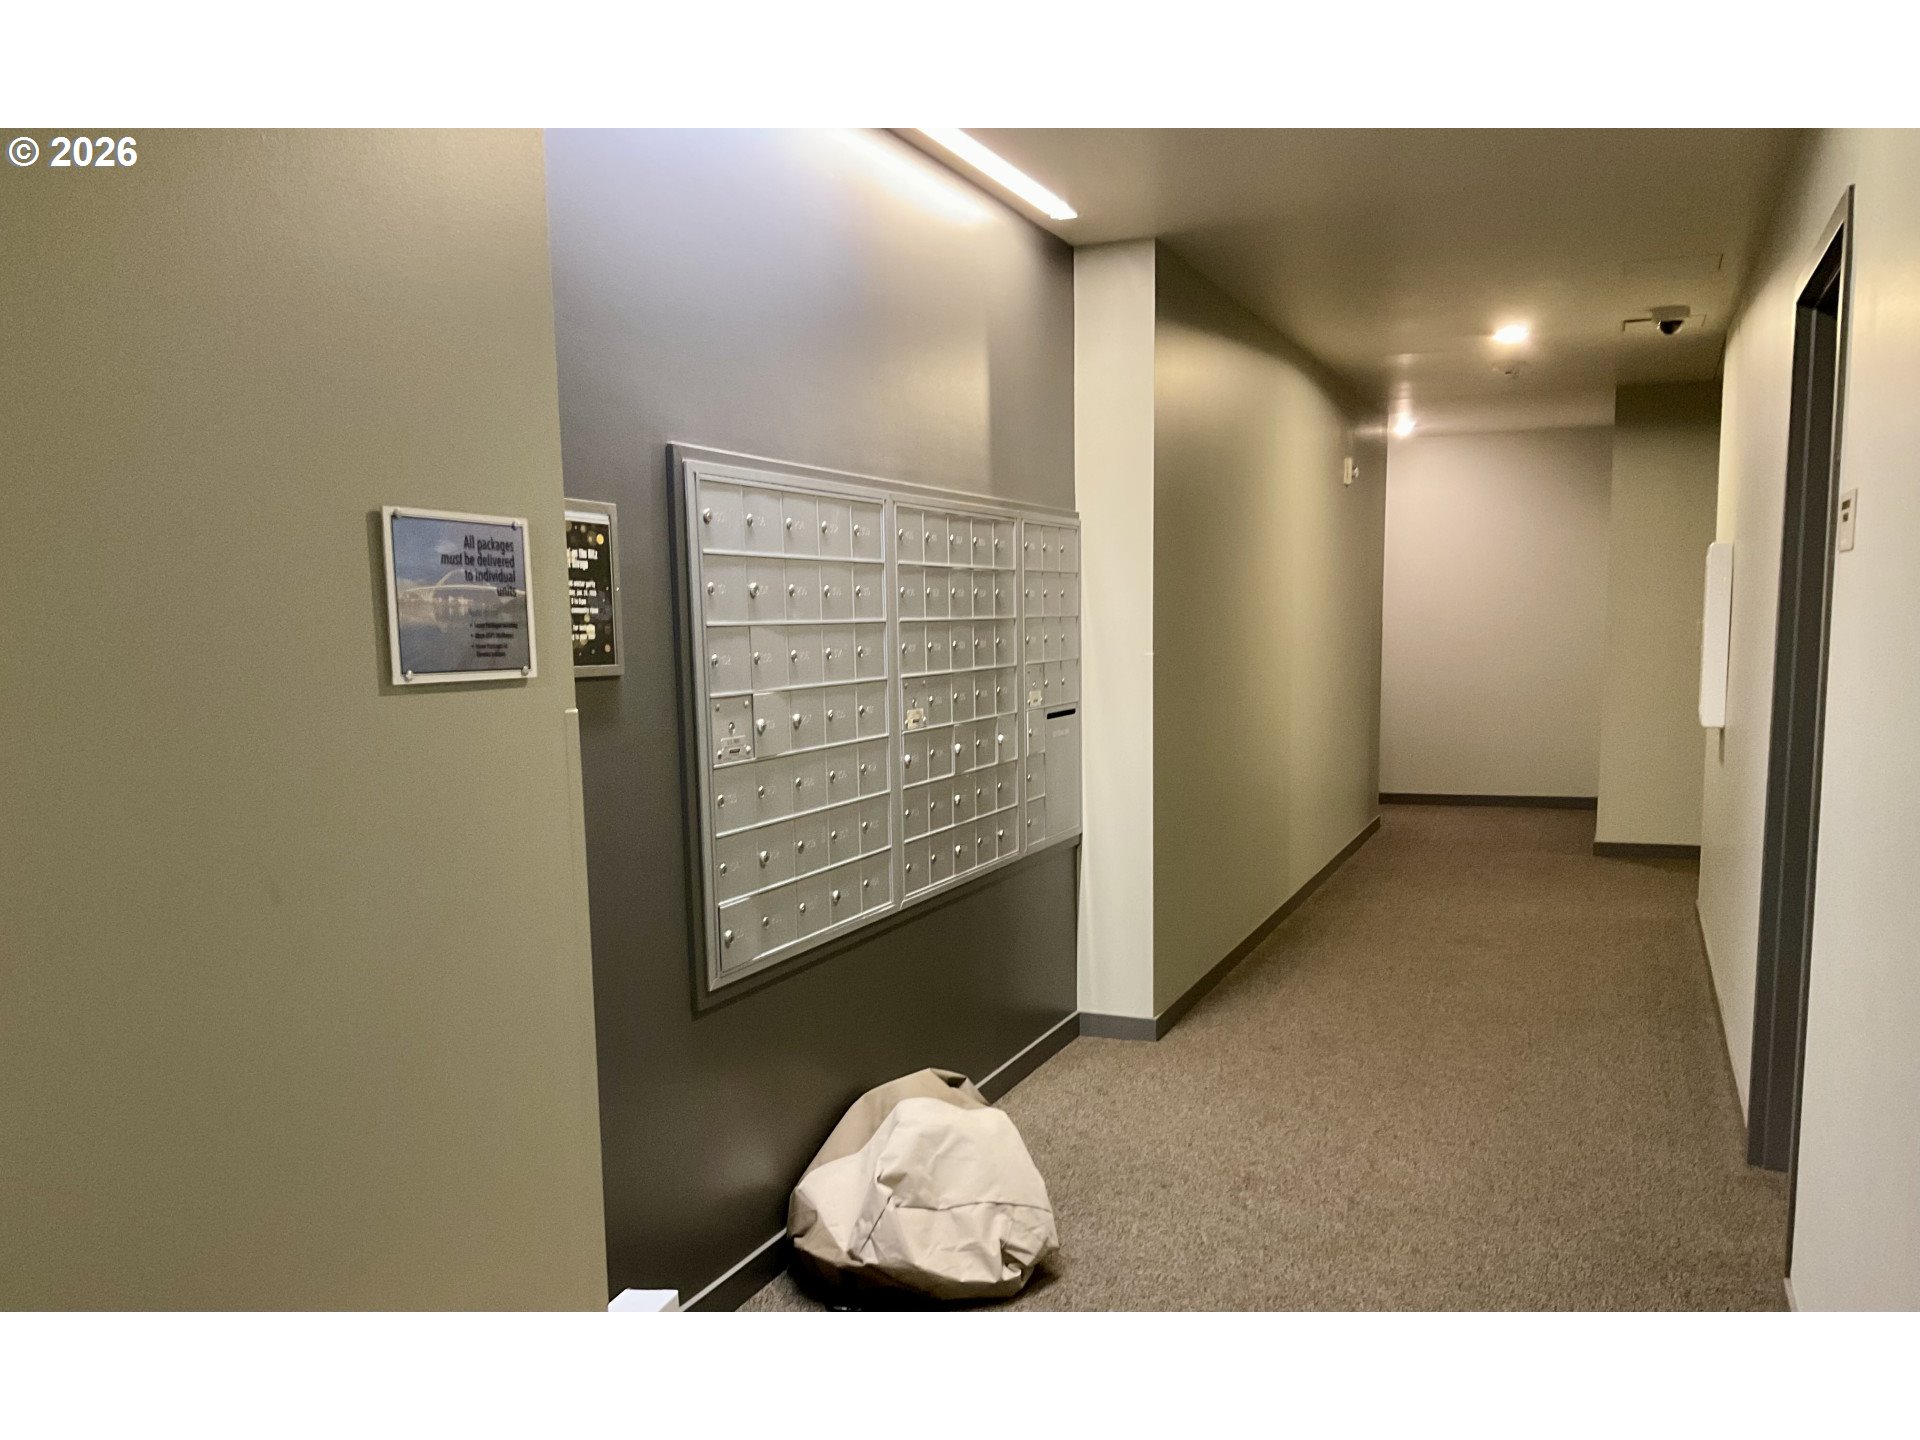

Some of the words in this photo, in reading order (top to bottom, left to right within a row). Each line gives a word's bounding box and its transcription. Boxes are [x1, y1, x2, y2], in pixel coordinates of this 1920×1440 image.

[464, 535, 475, 548] All
[477, 537, 514, 555] packages
[441, 553, 462, 565] must
[464, 551, 475, 566] be
[477, 553, 514, 568] delivered
[465, 569, 473, 582] to
[476, 569, 515, 582] individual
